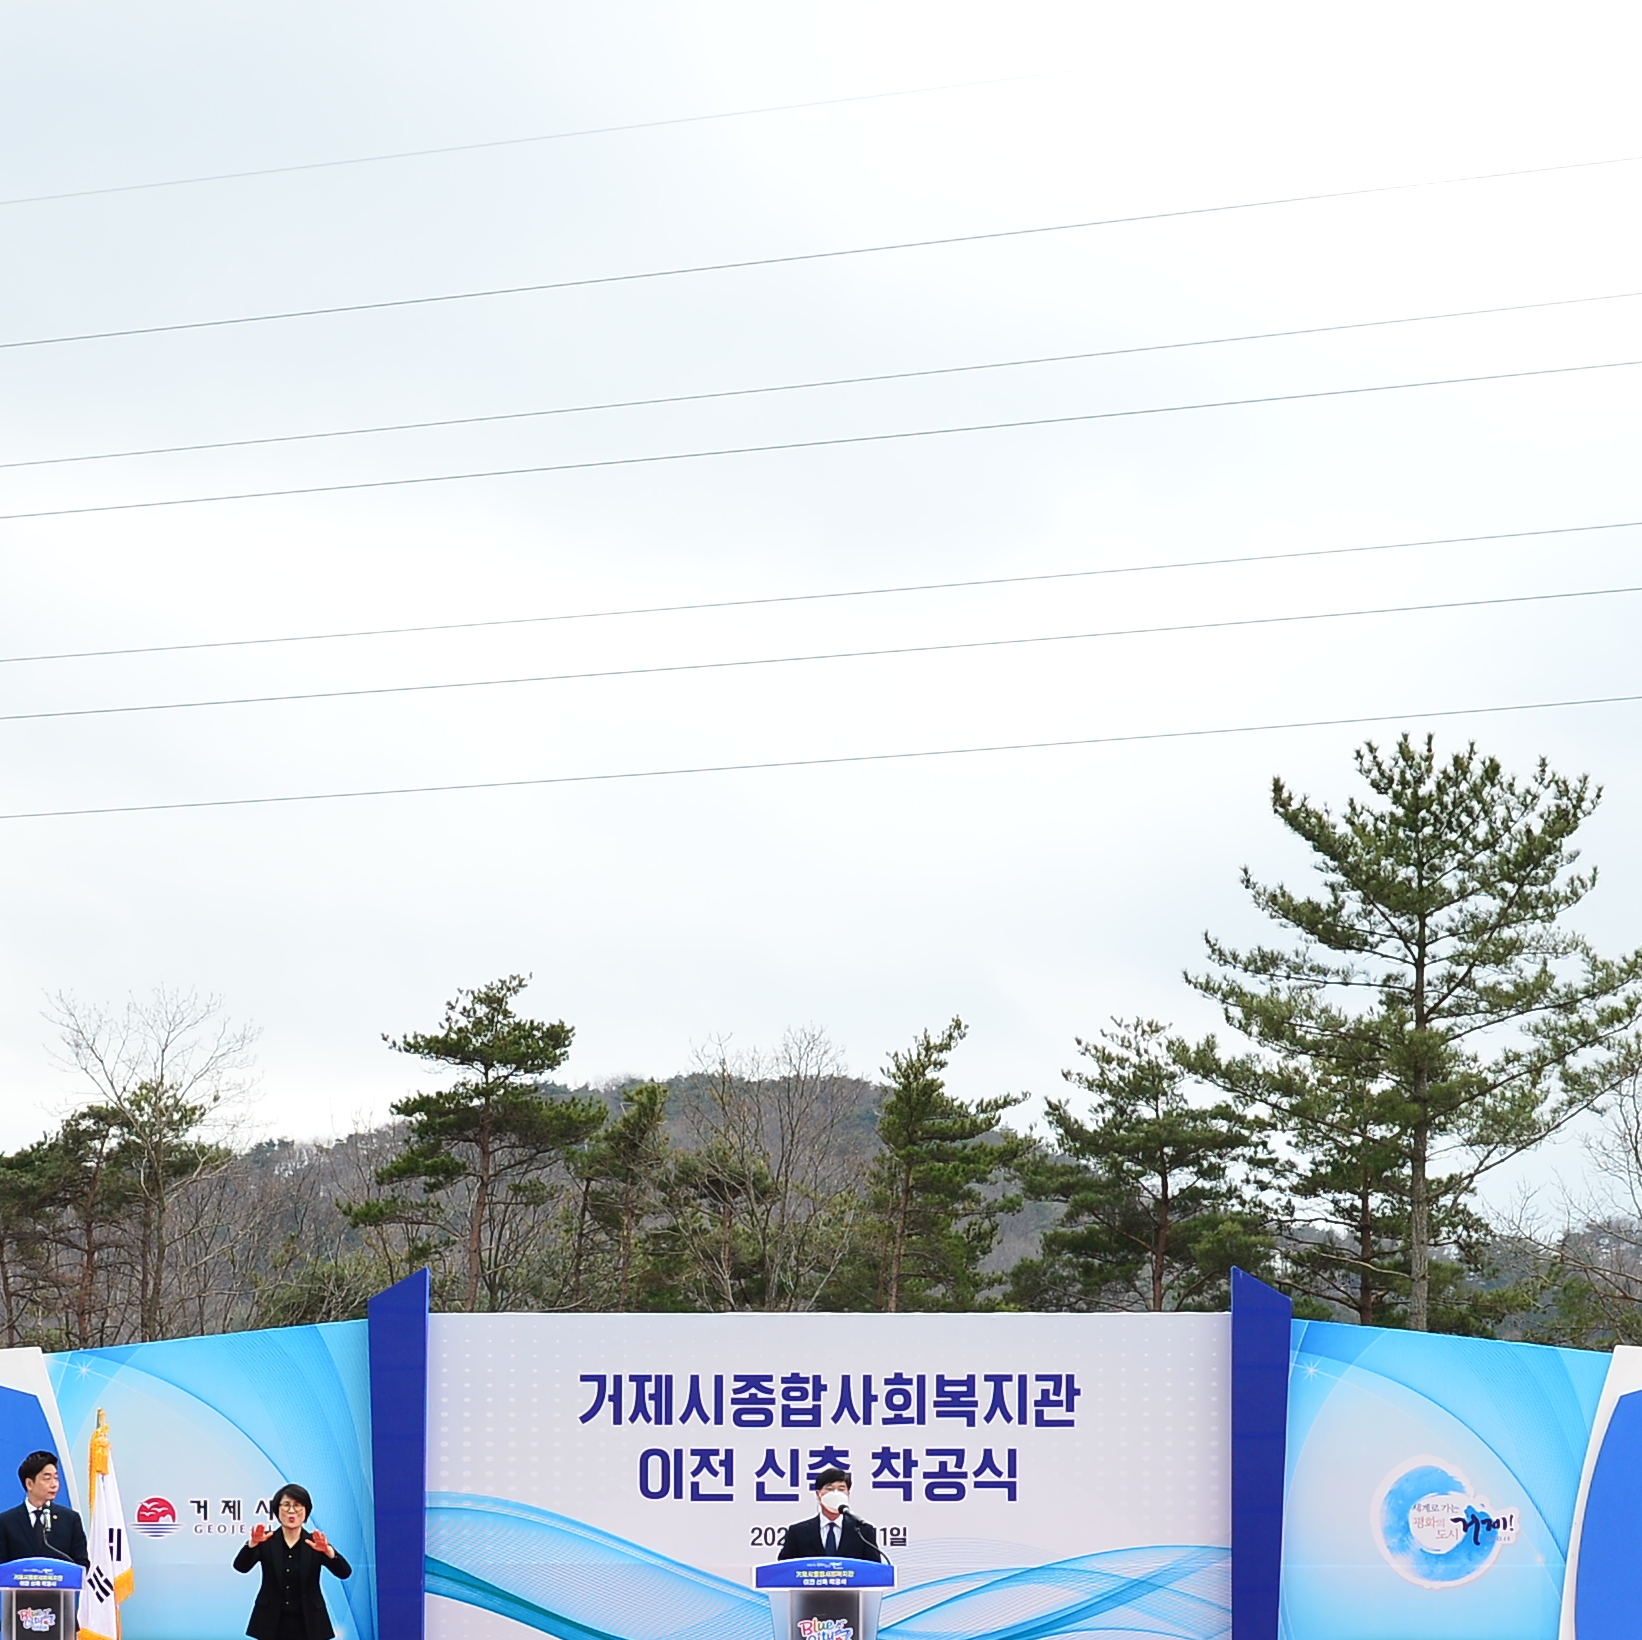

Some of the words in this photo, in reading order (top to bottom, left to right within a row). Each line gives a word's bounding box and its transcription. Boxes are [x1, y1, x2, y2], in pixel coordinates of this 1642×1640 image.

[577, 1372, 1081, 1428] 거제시종합사회복지관
[638, 1447, 735, 1502] 이전
[870, 1446, 1018, 1503] 착공식
[194, 1524, 246, 1535] GEOJE
[873, 1526, 908, 1547] 1일
[799, 1618, 835, 1636] Blue
